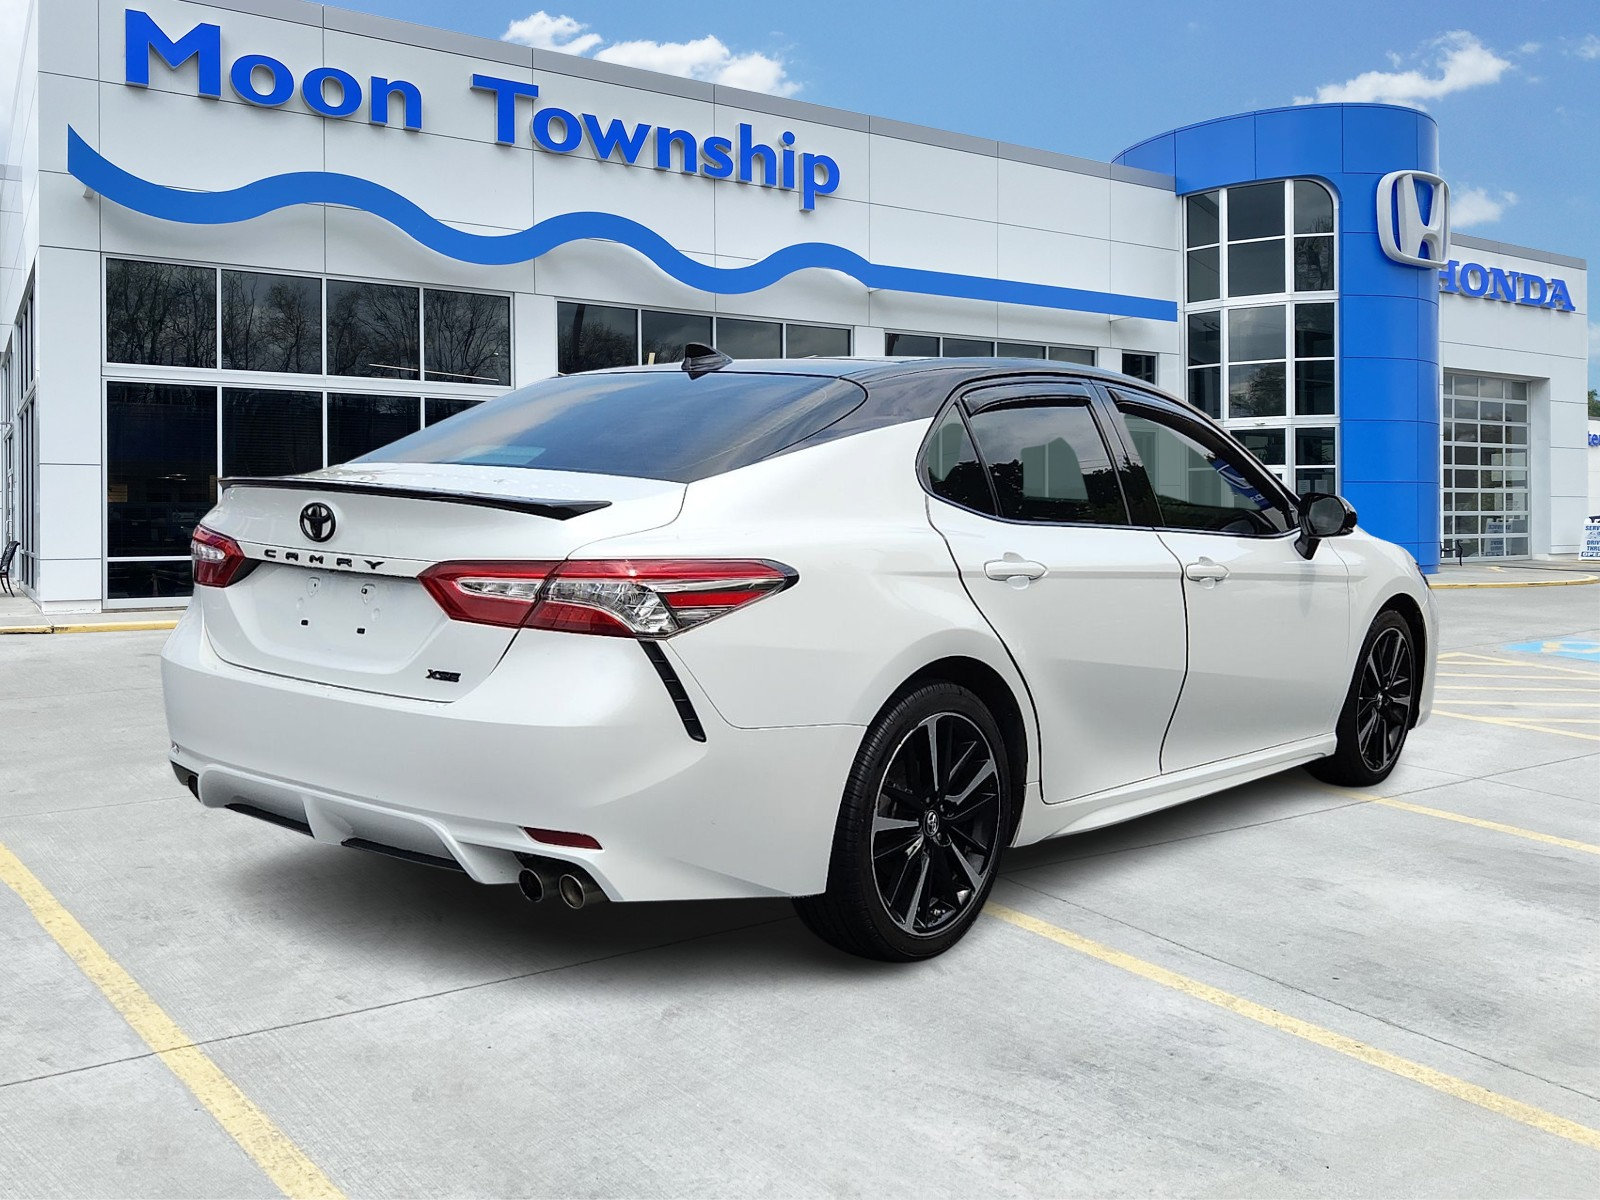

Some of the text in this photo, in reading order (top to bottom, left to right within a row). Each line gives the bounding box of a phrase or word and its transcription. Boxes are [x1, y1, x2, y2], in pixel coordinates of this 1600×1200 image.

[125, 8, 840, 212] Moon Township
[1439, 259, 1576, 312] HONDA
[264, 549, 385, 570] CAMRY
[425, 669, 461, 682] XSE
